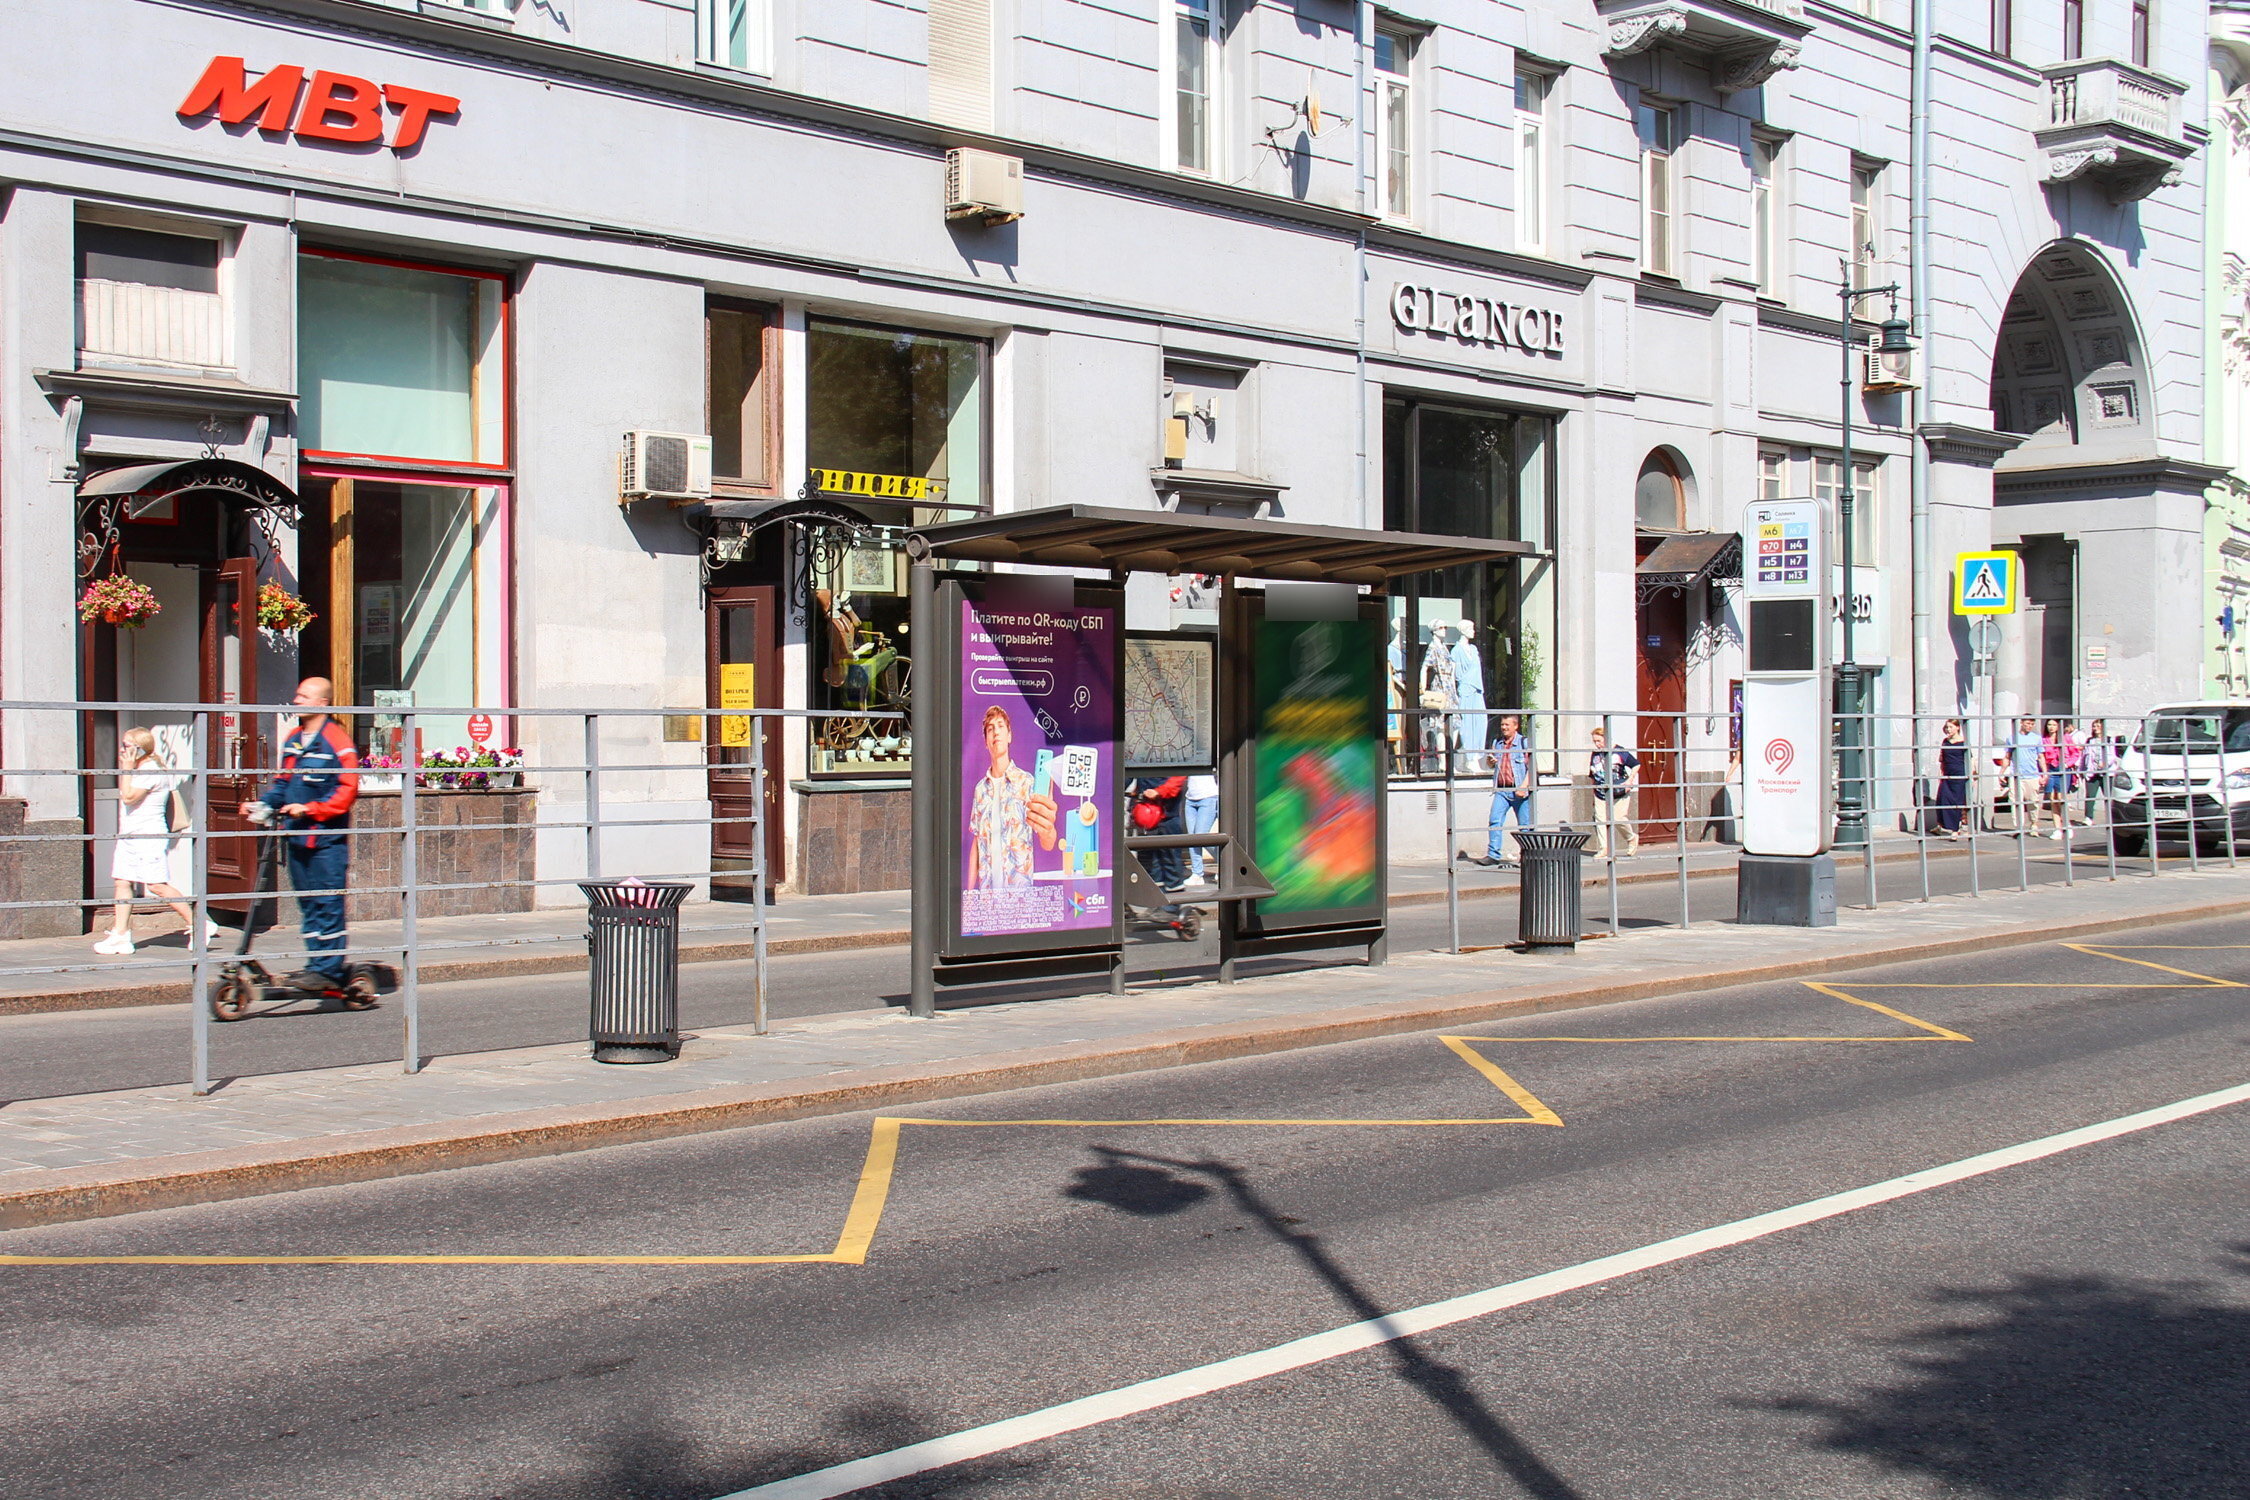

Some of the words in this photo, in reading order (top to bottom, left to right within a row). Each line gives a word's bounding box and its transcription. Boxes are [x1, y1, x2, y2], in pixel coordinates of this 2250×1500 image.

[177, 55, 461, 149] MBT
[810, 467, 930, 499] НЦИЯ
[971, 609, 1016, 625] Платите
[1018, 615, 1031, 627] по
[1033, 612, 1079, 632] QR-коду
[1081, 616, 1103, 630] СБП
[970, 633, 978, 642] и
[979, 632, 1053, 647] выигрывайте!
[971, 652, 1004, 663] Проверяйте
[1038, 655, 1054, 664] сайте
[978, 676, 1046, 689] быстрыеплатежи.рф
[1760, 785, 1798, 794] Транспорт
